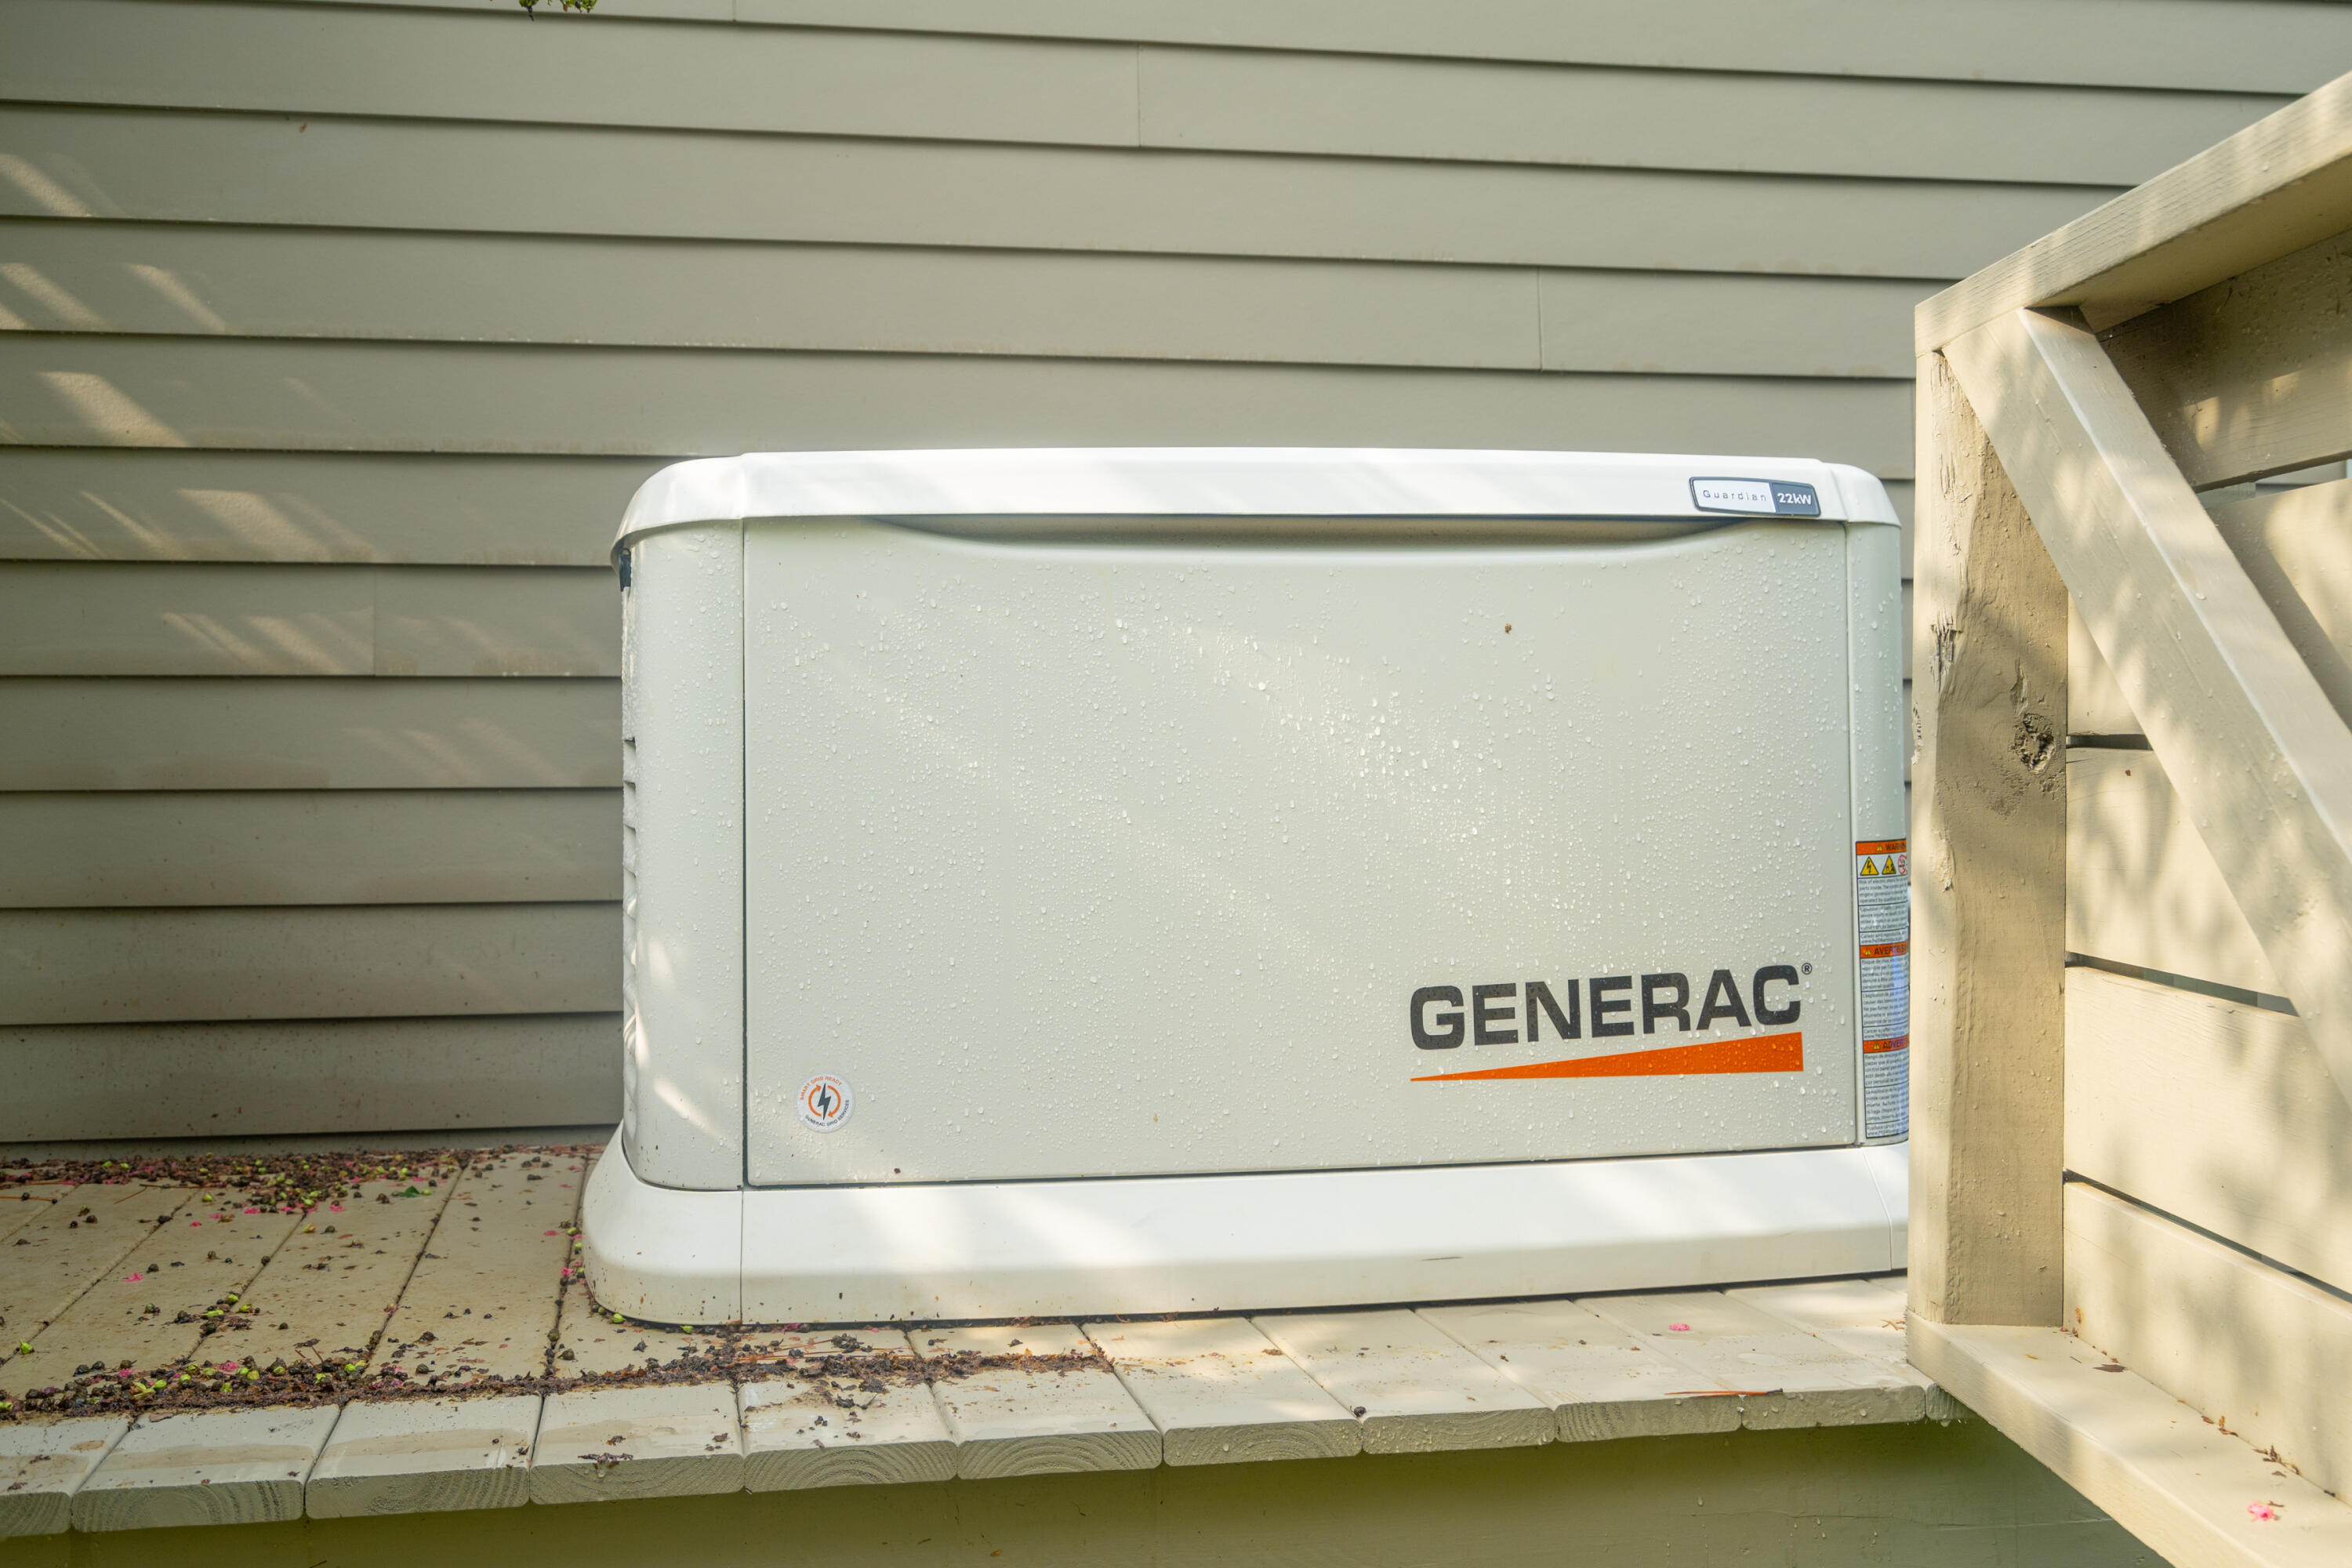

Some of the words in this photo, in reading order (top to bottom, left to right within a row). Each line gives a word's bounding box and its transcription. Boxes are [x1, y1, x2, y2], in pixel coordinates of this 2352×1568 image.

[1703, 489, 1766, 502] Guardian
[1777, 492, 1812, 505] 22kW
[1410, 964, 1801, 1050] GENERAC
[811, 1076, 824, 1084] GRID
[825, 1076, 843, 1086] READY
[805, 1115, 826, 1127] GENERAC
